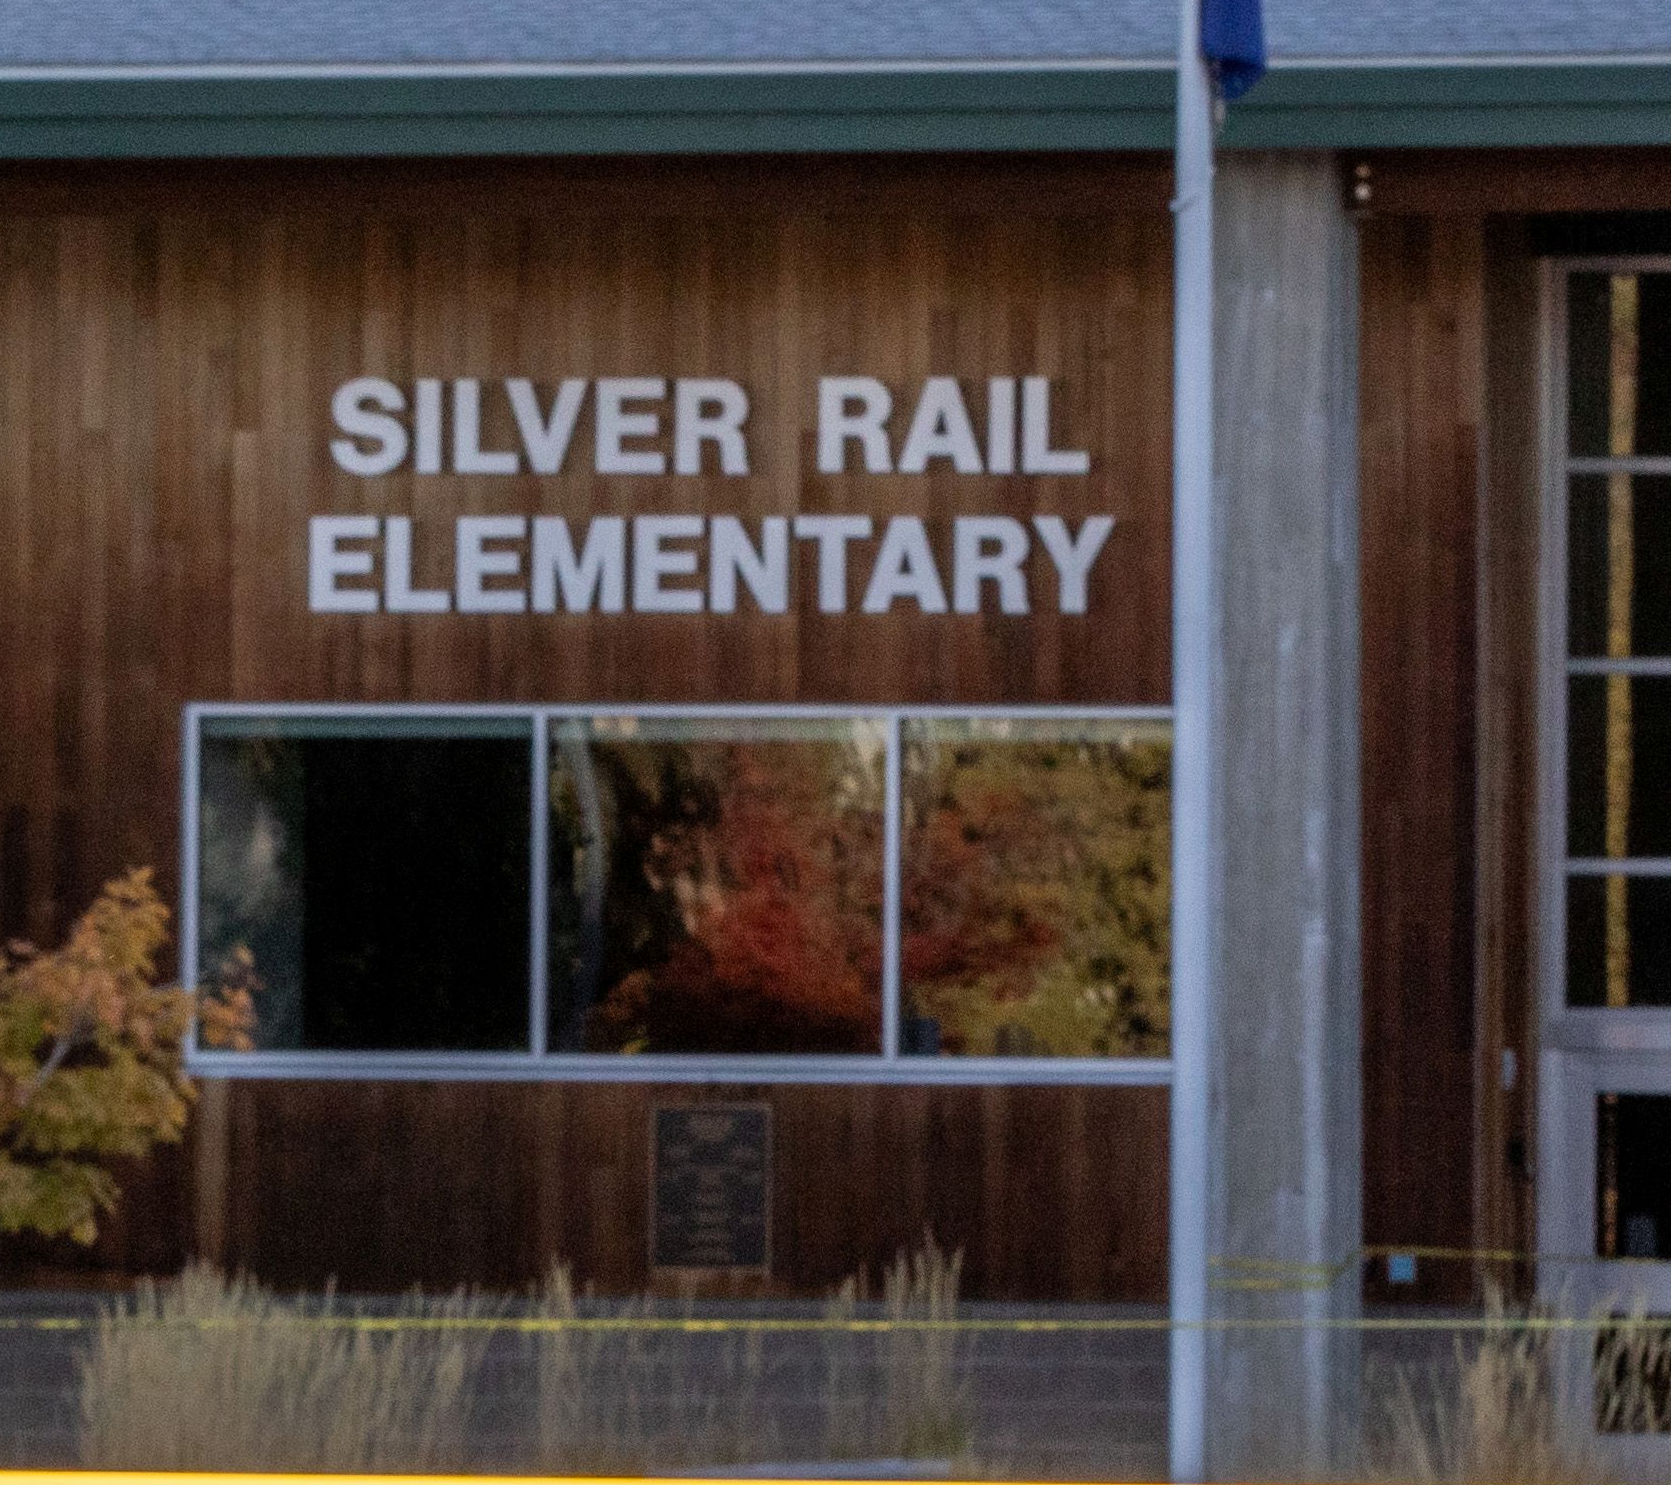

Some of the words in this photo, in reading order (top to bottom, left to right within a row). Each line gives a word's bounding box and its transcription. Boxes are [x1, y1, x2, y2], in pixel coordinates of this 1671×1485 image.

[329, 375, 749, 477] SILVER
[817, 376, 1090, 475] RAIL
[309, 514, 1115, 614] ELEMENTARY
